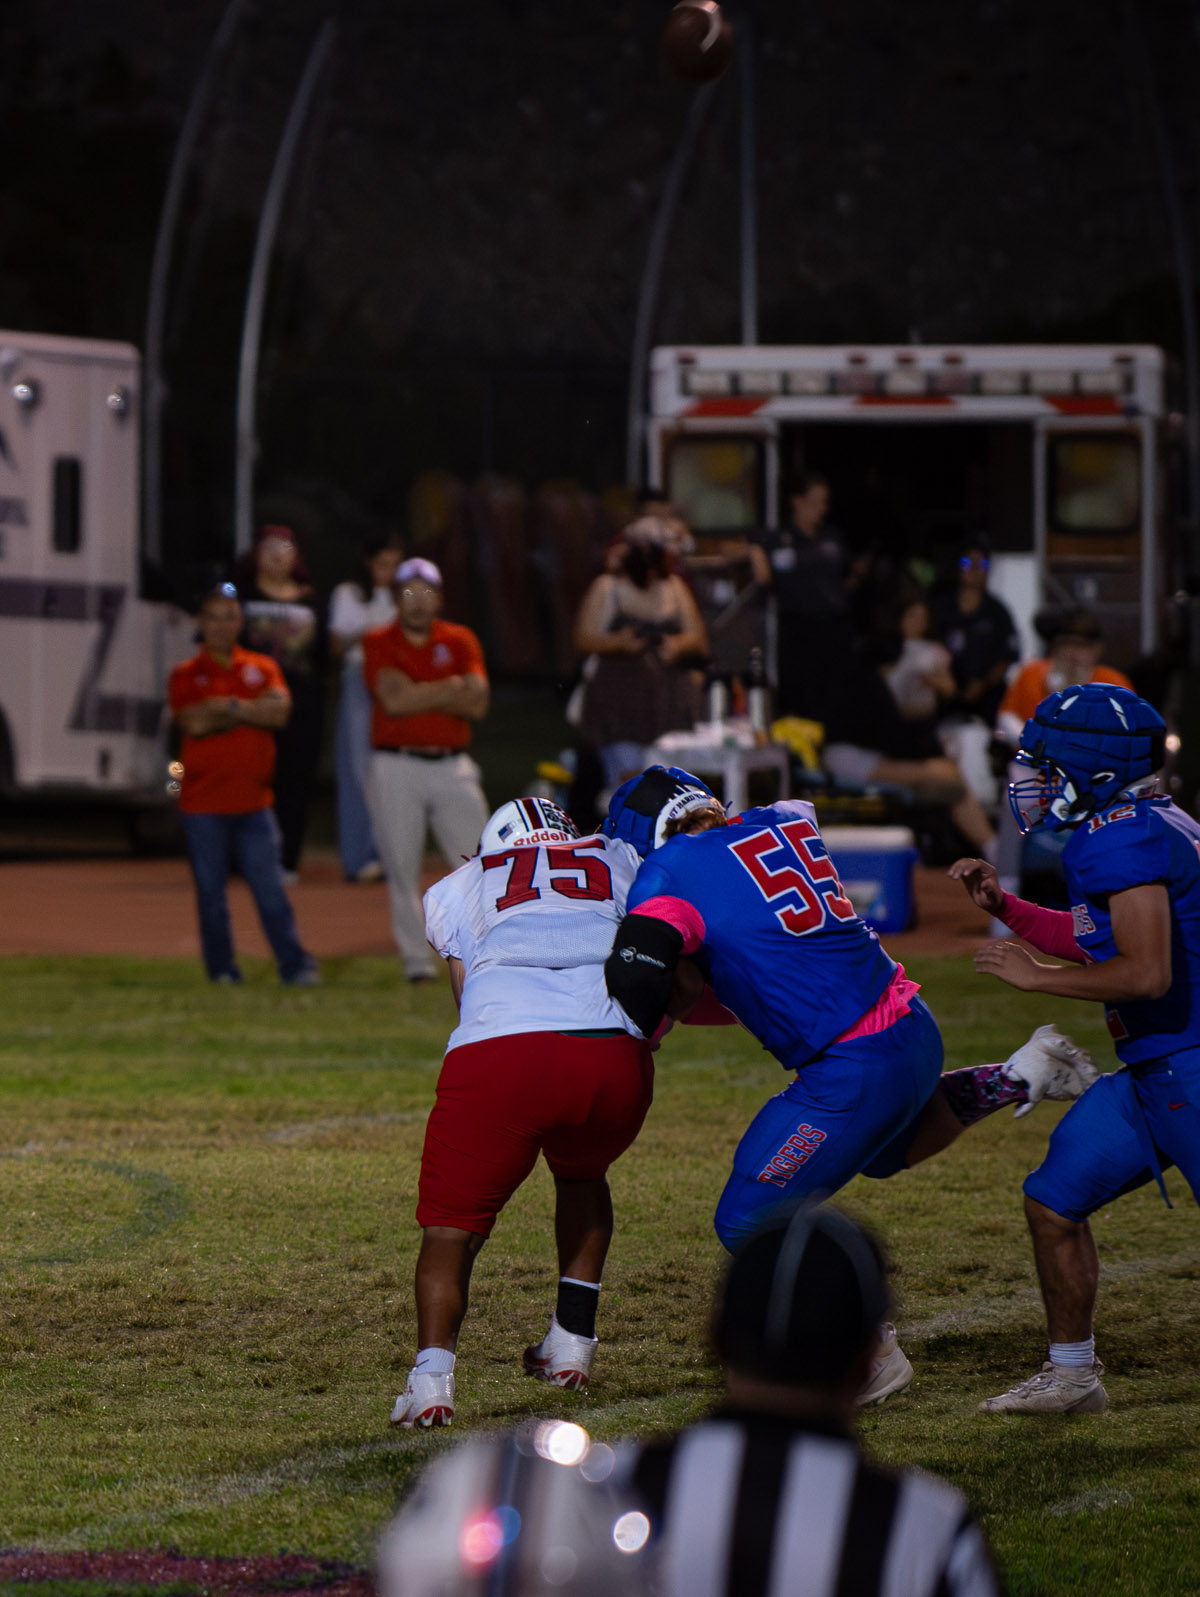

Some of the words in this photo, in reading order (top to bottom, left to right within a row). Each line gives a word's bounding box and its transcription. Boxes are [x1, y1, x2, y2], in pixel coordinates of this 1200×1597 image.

[513, 831, 569, 847] Riddell
[1087, 804, 1137, 835] 12
[481, 838, 613, 912] 75
[726, 818, 858, 938] 55
[756, 1122, 828, 1188] TIGERS
